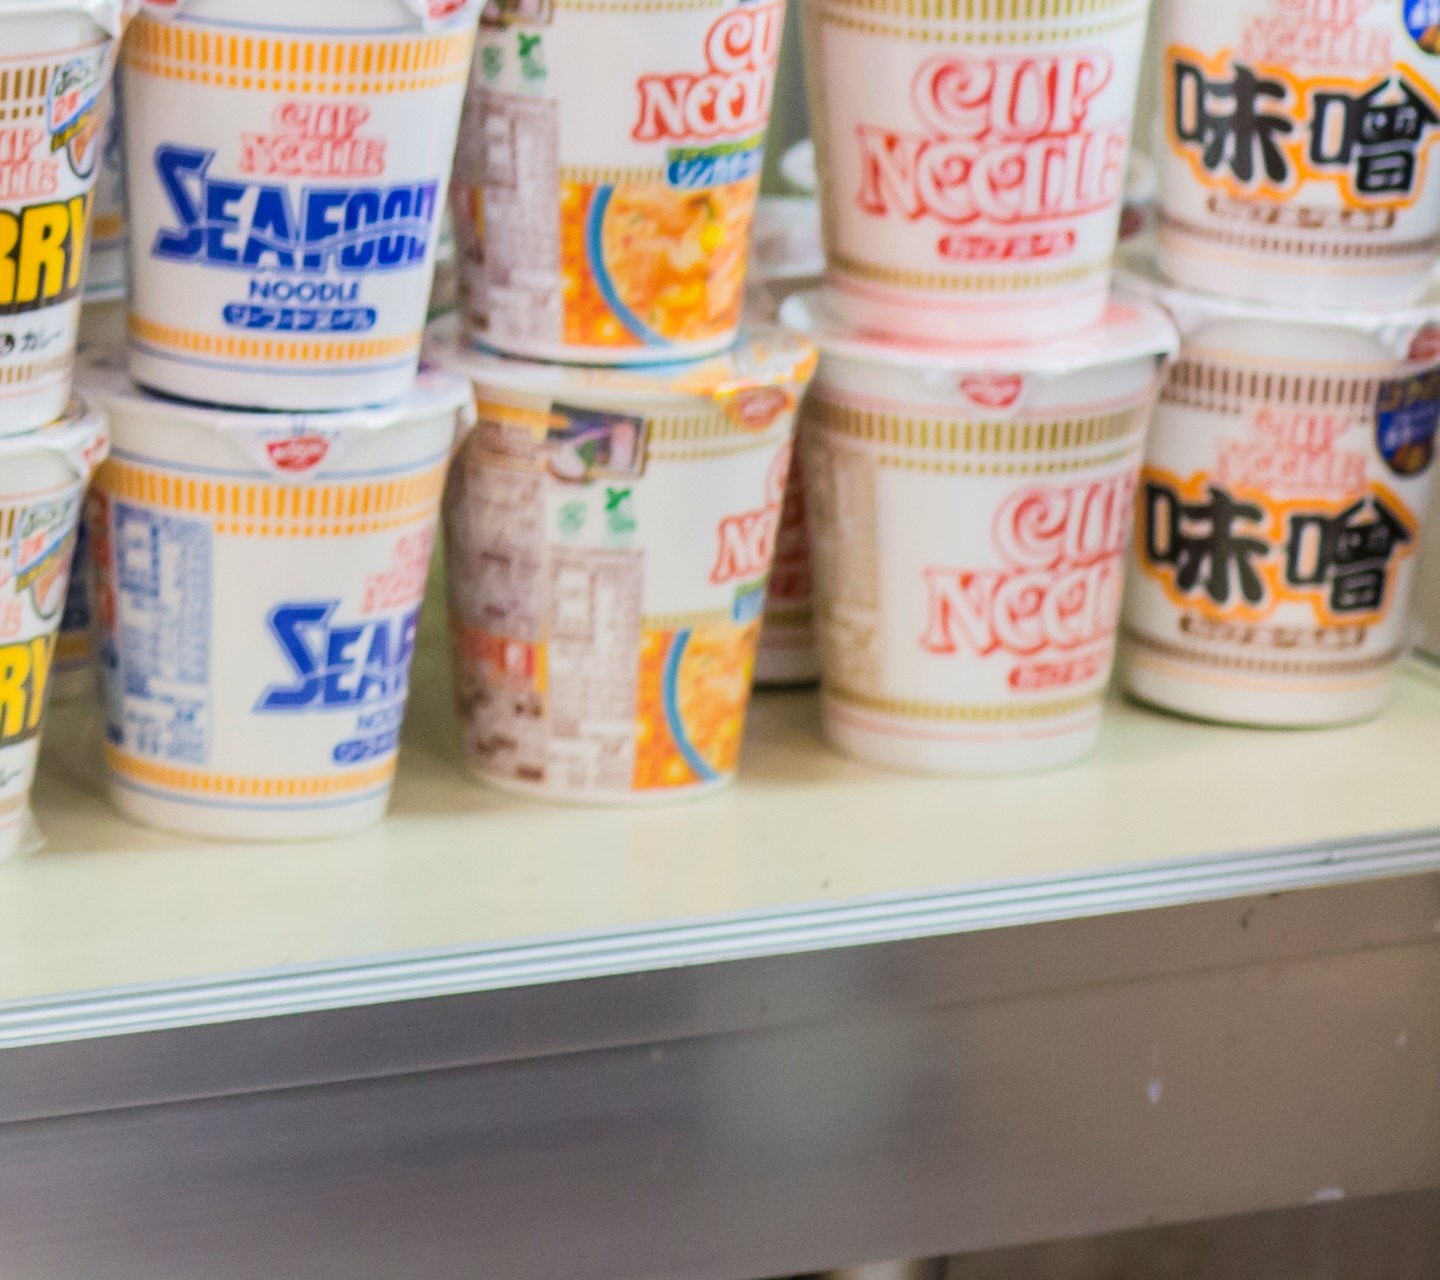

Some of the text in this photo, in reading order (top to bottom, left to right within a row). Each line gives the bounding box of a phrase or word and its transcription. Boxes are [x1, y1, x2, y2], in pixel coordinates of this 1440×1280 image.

[1170, 60, 1440, 198] 味噌
[248, 280, 361, 303] NOODLE
[1143, 481, 1412, 613] 味噌
